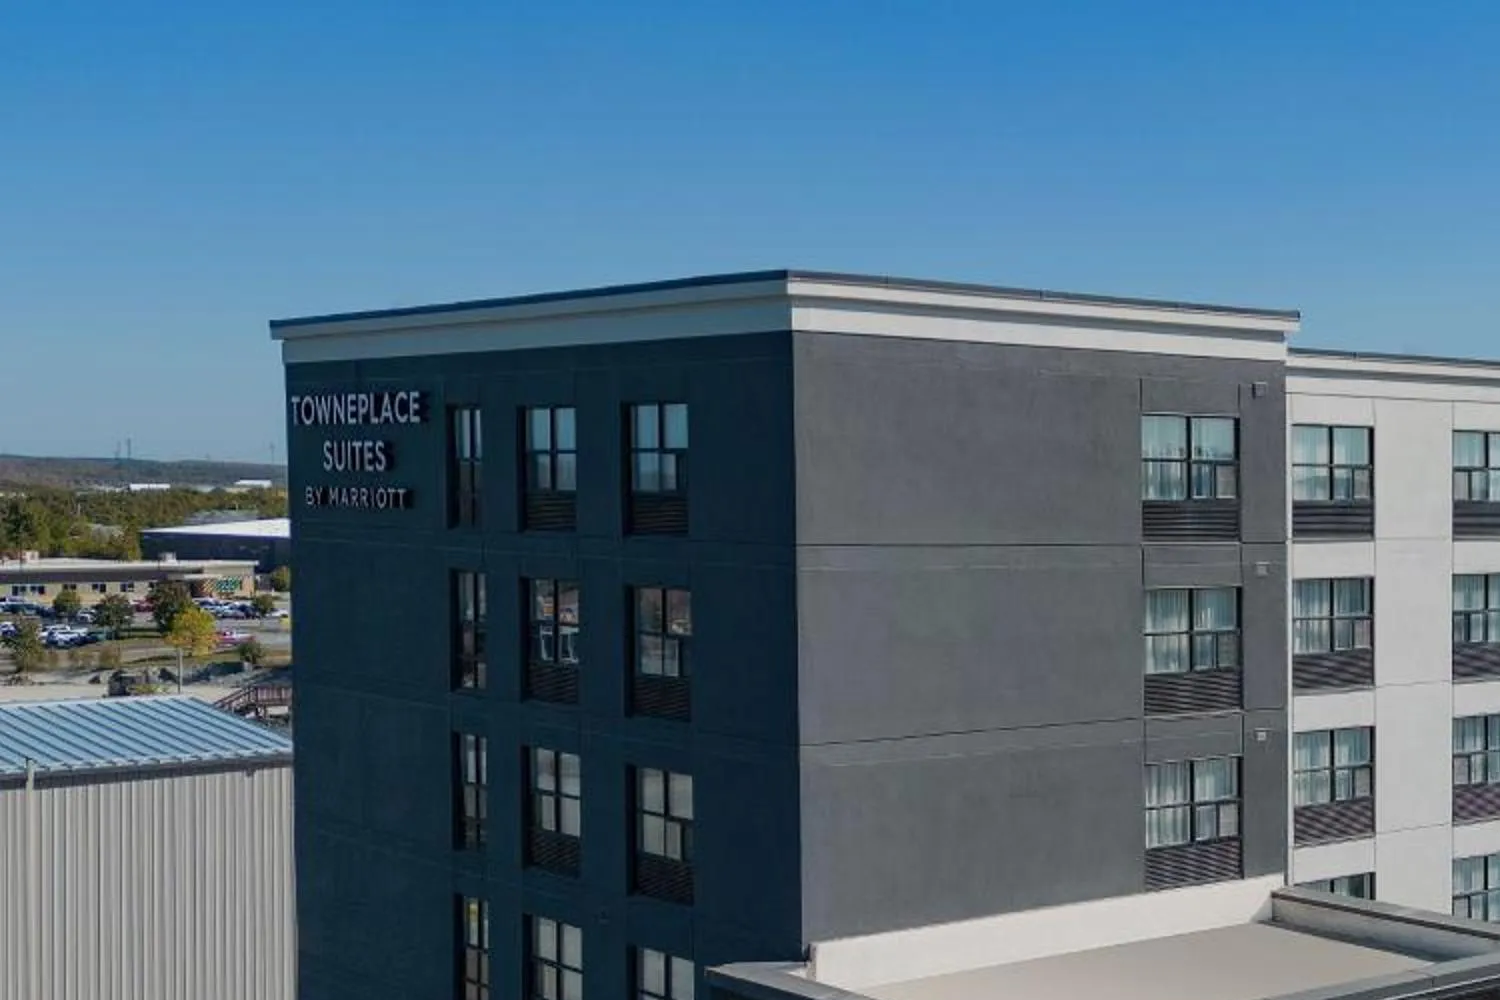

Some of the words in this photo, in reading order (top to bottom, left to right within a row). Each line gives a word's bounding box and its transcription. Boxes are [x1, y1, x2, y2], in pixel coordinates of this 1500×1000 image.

[291, 391, 421, 426] TOWNEPLACE
[323, 439, 387, 472] SUITES
[305, 486, 324, 505] BY
[329, 487, 408, 510] MARRIOTT
